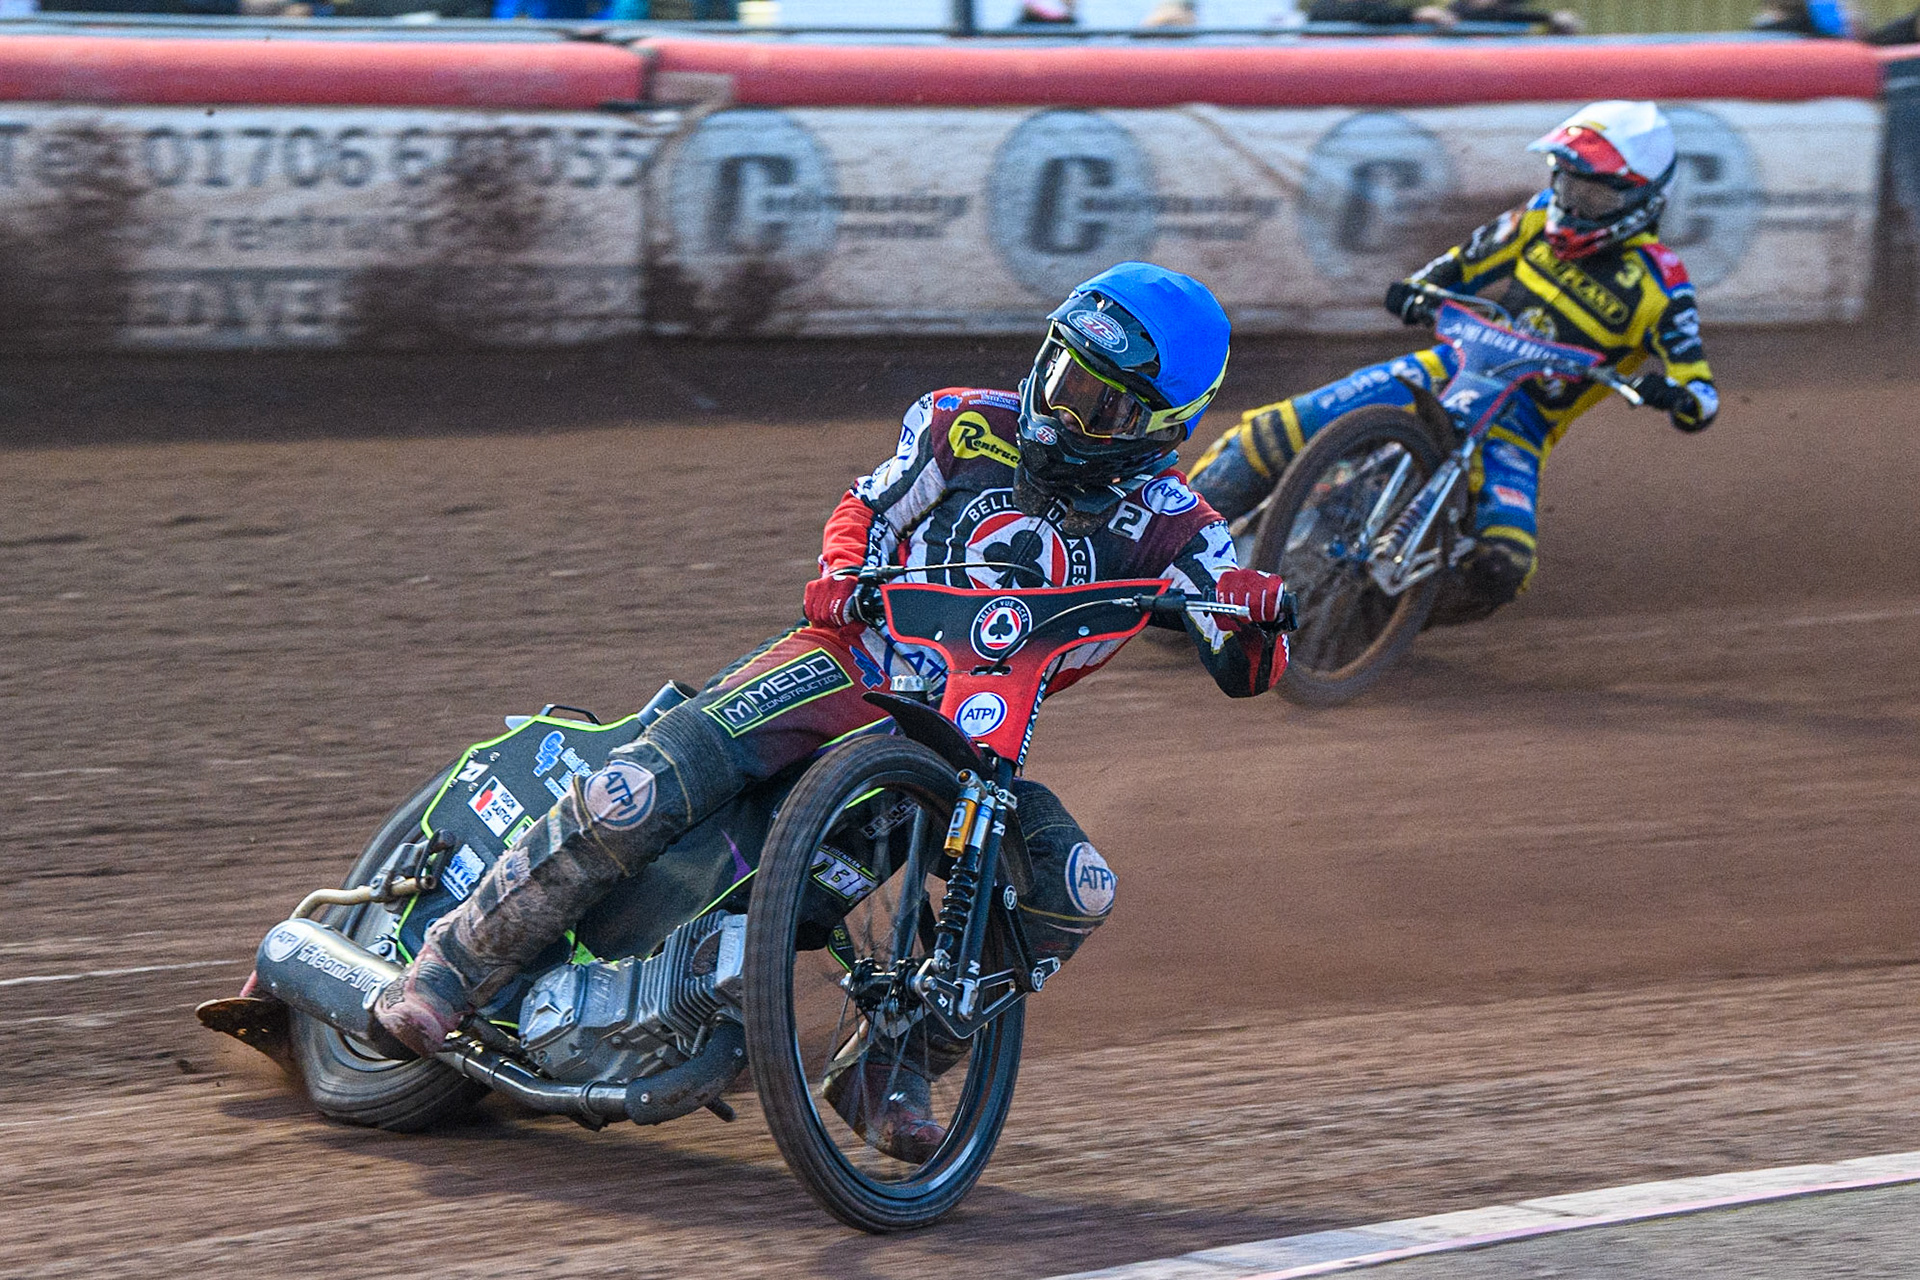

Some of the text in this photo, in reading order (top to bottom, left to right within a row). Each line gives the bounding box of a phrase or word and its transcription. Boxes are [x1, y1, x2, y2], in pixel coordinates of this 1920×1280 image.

[143, 123, 376, 190] 01706
[957, 420, 1021, 464] Rentruc
[967, 494, 1018, 522] BELL
[1152, 483, 1187, 504] ATPI
[1113, 505, 1142, 537] 2
[1066, 539, 1087, 586] ACES
[977, 602, 997, 623] BELLE
[1000, 600, 1016, 608] VUE
[758, 672, 842, 713] CONSTRUCTION
[962, 707, 997, 721] ATPI
[603, 771, 638, 816] ATPI
